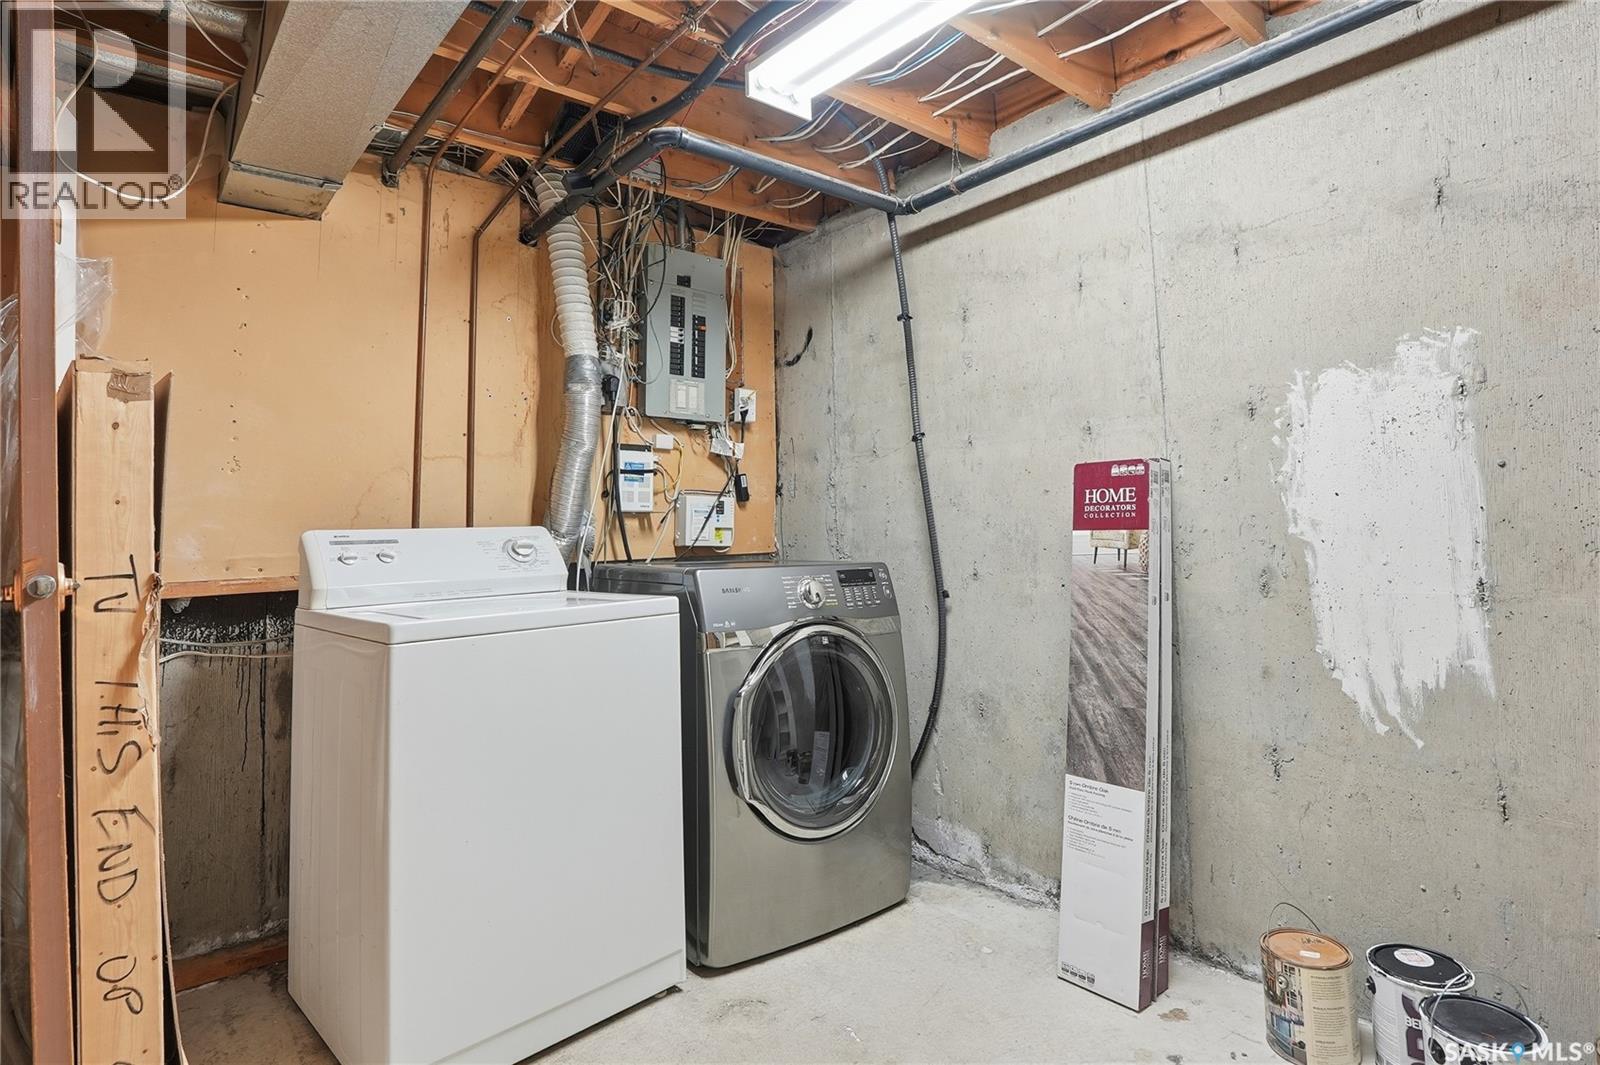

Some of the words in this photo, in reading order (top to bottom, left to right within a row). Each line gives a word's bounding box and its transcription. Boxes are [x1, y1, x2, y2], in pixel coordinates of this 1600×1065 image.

[1084, 487, 1137, 504] HOME
[1084, 504, 1137, 512] DECORATORS
[1083, 511, 1137, 519] COLLECTION
[91, 804, 156, 904] END
